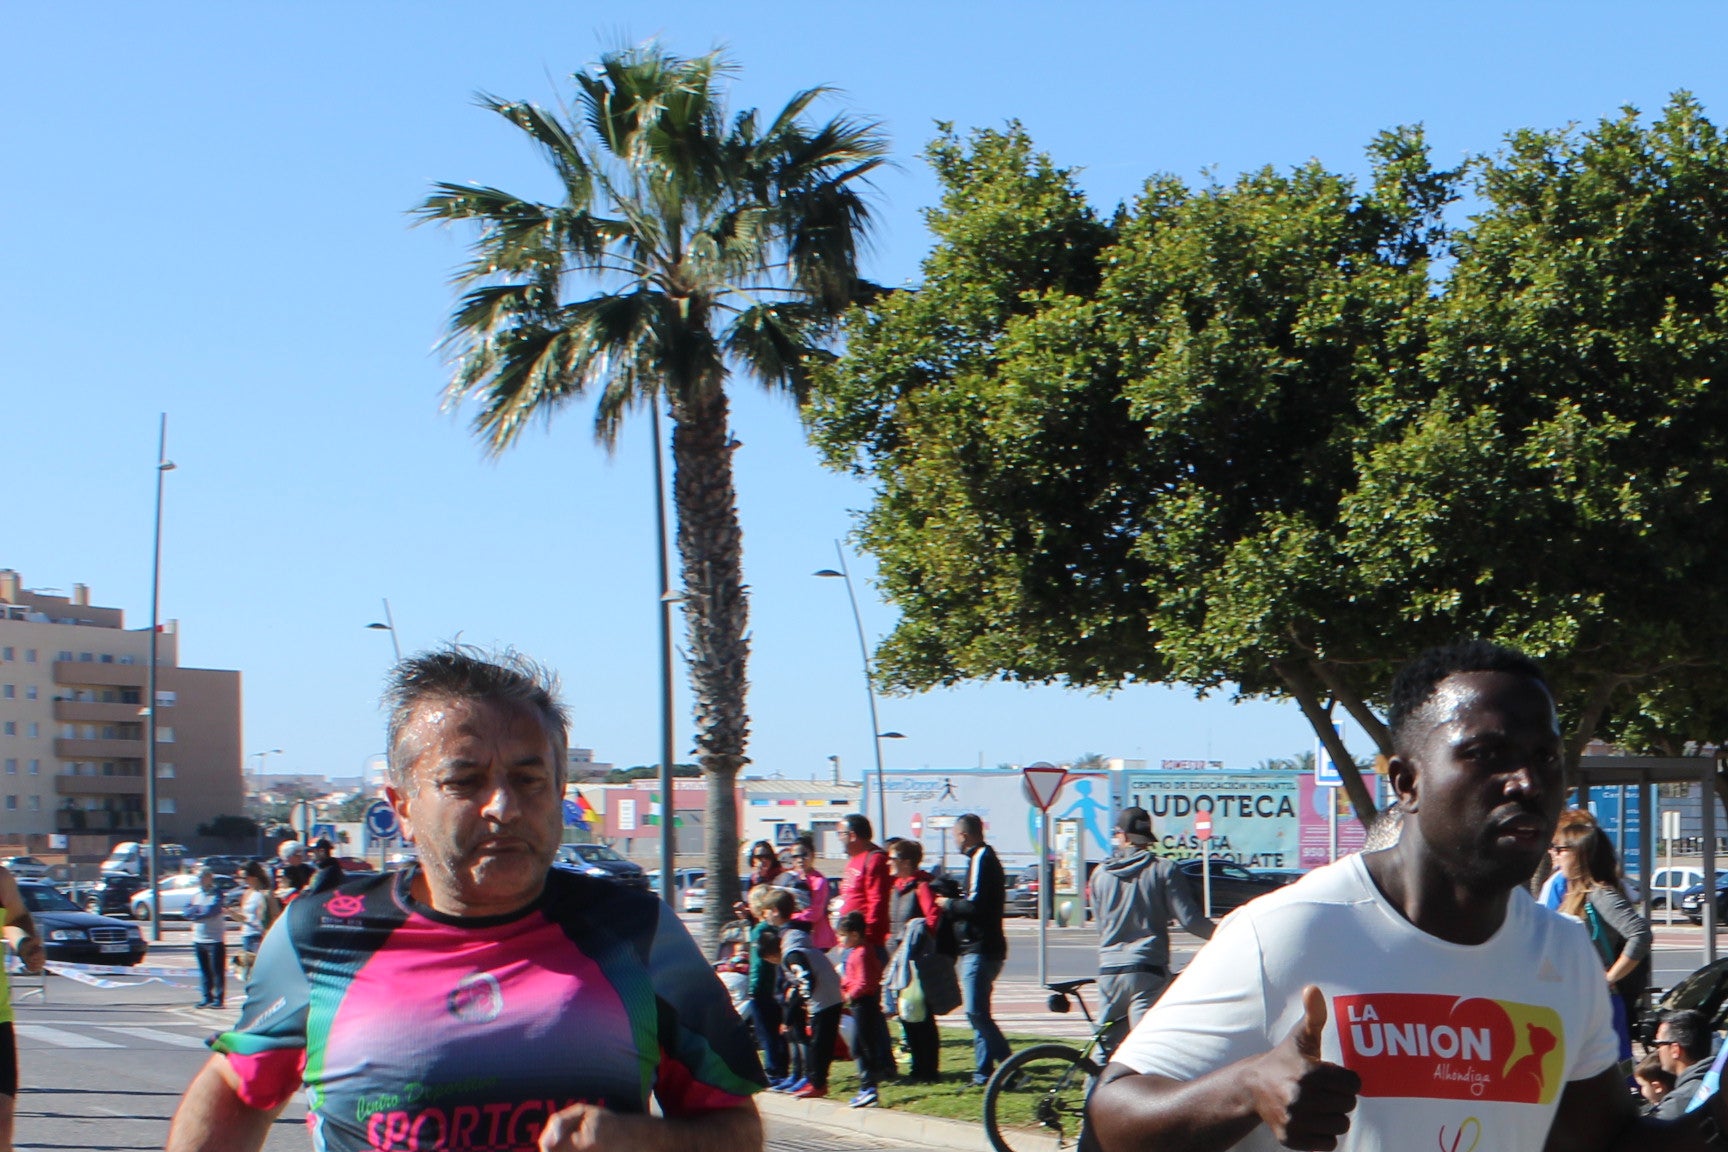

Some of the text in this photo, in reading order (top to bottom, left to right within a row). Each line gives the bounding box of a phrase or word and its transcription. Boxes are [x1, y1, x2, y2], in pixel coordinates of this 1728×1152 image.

[1131, 781, 1171, 790] CENTRO
[1174, 781, 1186, 790] DE
[1132, 794, 1296, 818] LUDOTECA
[1163, 835, 1230, 849] CASTA
[1163, 852, 1284, 868] OLATE
[1347, 1004, 1379, 1022] LA
[1350, 1023, 1491, 1061] UNION
[356, 1095, 398, 1122] Centro
[367, 1098, 606, 1151] SPORTG
